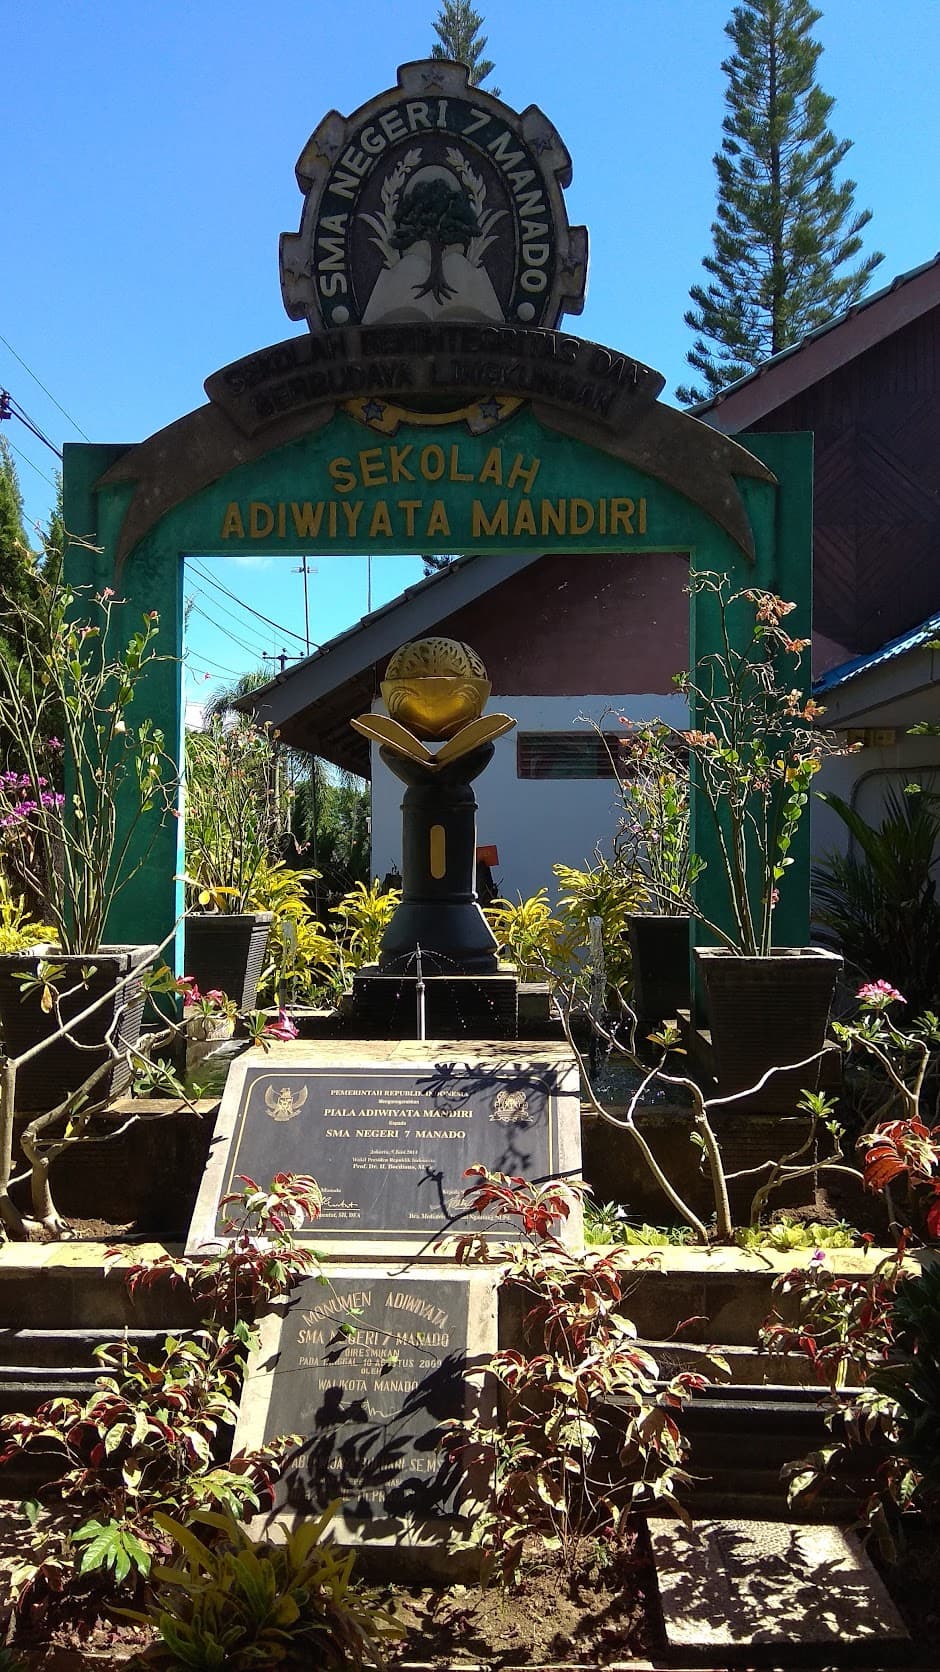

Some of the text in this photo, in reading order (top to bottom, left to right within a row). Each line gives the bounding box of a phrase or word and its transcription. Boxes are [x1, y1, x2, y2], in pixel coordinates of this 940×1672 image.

[318, 100, 551, 298] SMA NEGERI 7 MANADO
[328, 444, 541, 494] SEKOLAH
[220, 497, 648, 539] ADIWIYATA MANDIRI
[330, 1089, 383, 1097] PEMERINTAH
[384, 1089, 424, 1097] REPUBLIK
[323, 1108, 473, 1118] PIALA ADIWIYATA MANDIRI
[325, 1129, 466, 1139] SMA NEGERI 7 MANADO
[302, 1290, 449, 1329] MONUMEN ADIWIYATA
[296, 1329, 325, 1344] SMA
[395, 1330, 449, 1348] MANADO
[345, 1347, 400, 1358] DIRESMIKAN
[298, 1356, 319, 1366] PADA
[418, 1359, 442, 1369] 2009
[318, 1378, 418, 1393] WALIKOTA MANADO
